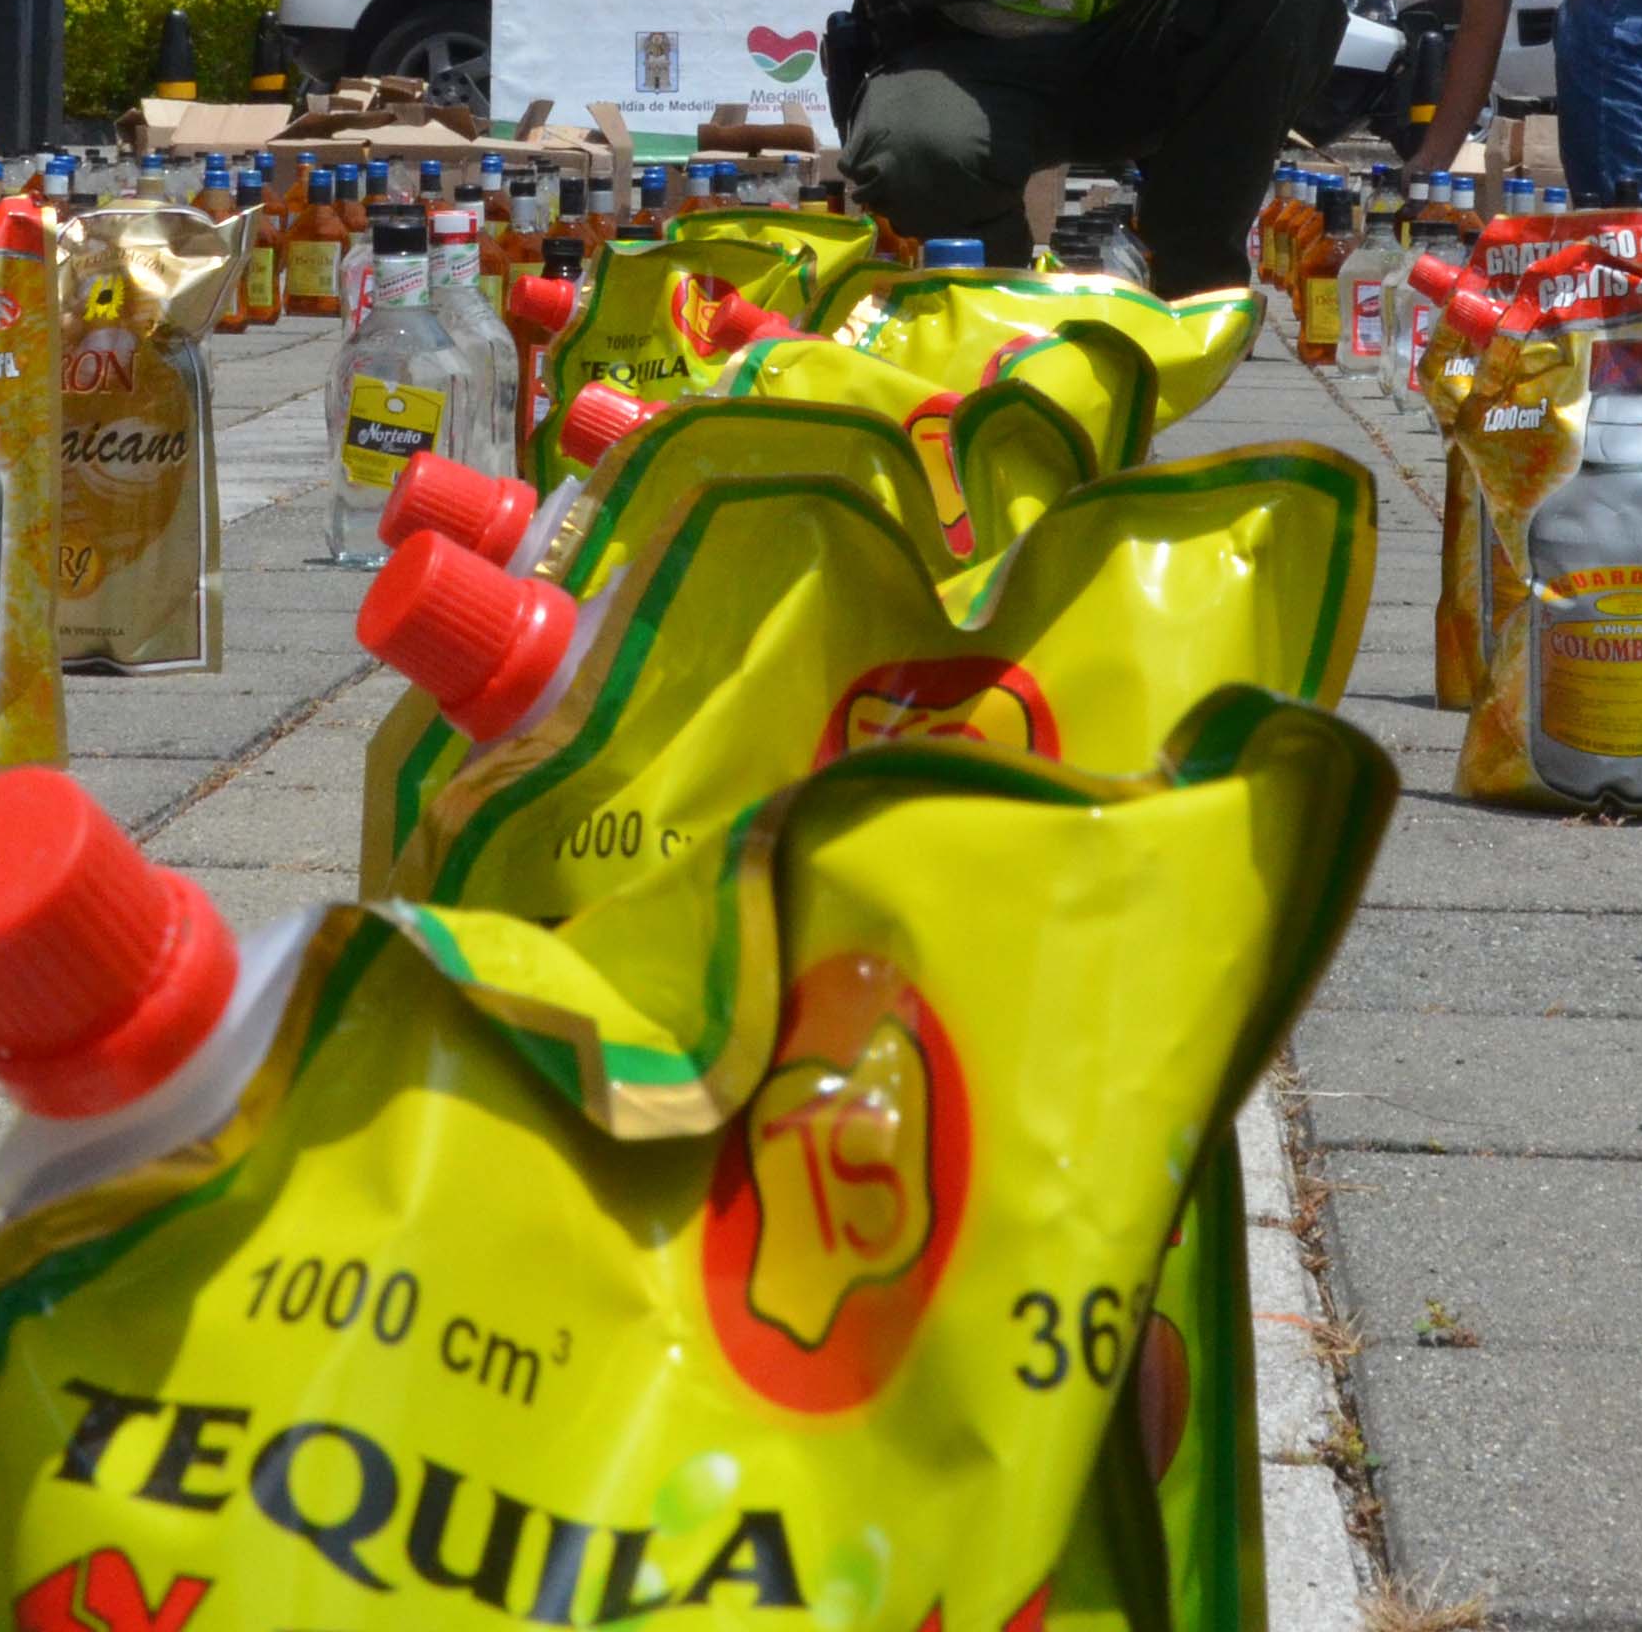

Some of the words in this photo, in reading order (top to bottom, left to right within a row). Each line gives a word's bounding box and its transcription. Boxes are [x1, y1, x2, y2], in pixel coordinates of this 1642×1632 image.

[649, 100, 665, 113] de
[668, 100, 718, 113] Medellí
[750, 88, 818, 105] Medellín
[245, 1257, 422, 1348] 1000
[54, 1377, 813, 1629] TEQUILA
